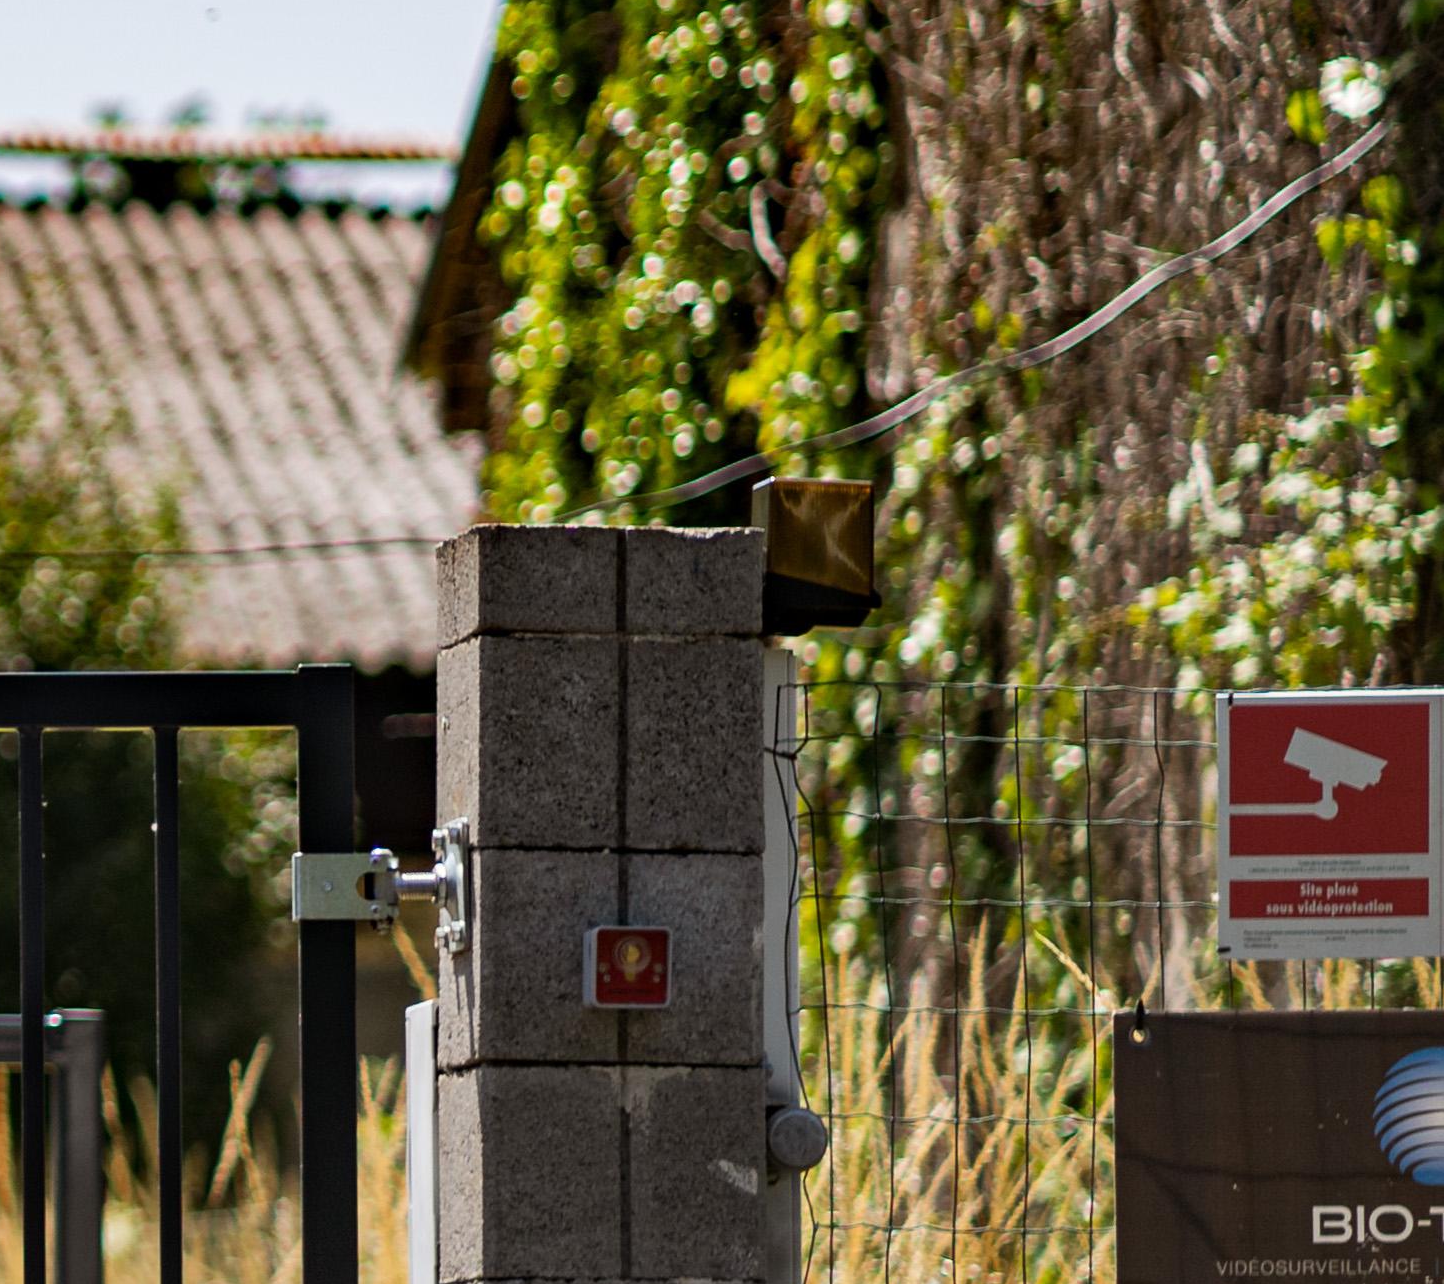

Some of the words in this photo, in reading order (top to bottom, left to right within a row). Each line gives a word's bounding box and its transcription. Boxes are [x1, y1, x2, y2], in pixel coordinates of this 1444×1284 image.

[1300, 882, 1323, 897] Site
[1327, 881, 1358, 900] placé
[1266, 902, 1293, 915] sous
[1298, 898, 1393, 916] vidéoprotection
[1217, 1257, 1421, 1276] VIDÉOSURVEILLANCE
